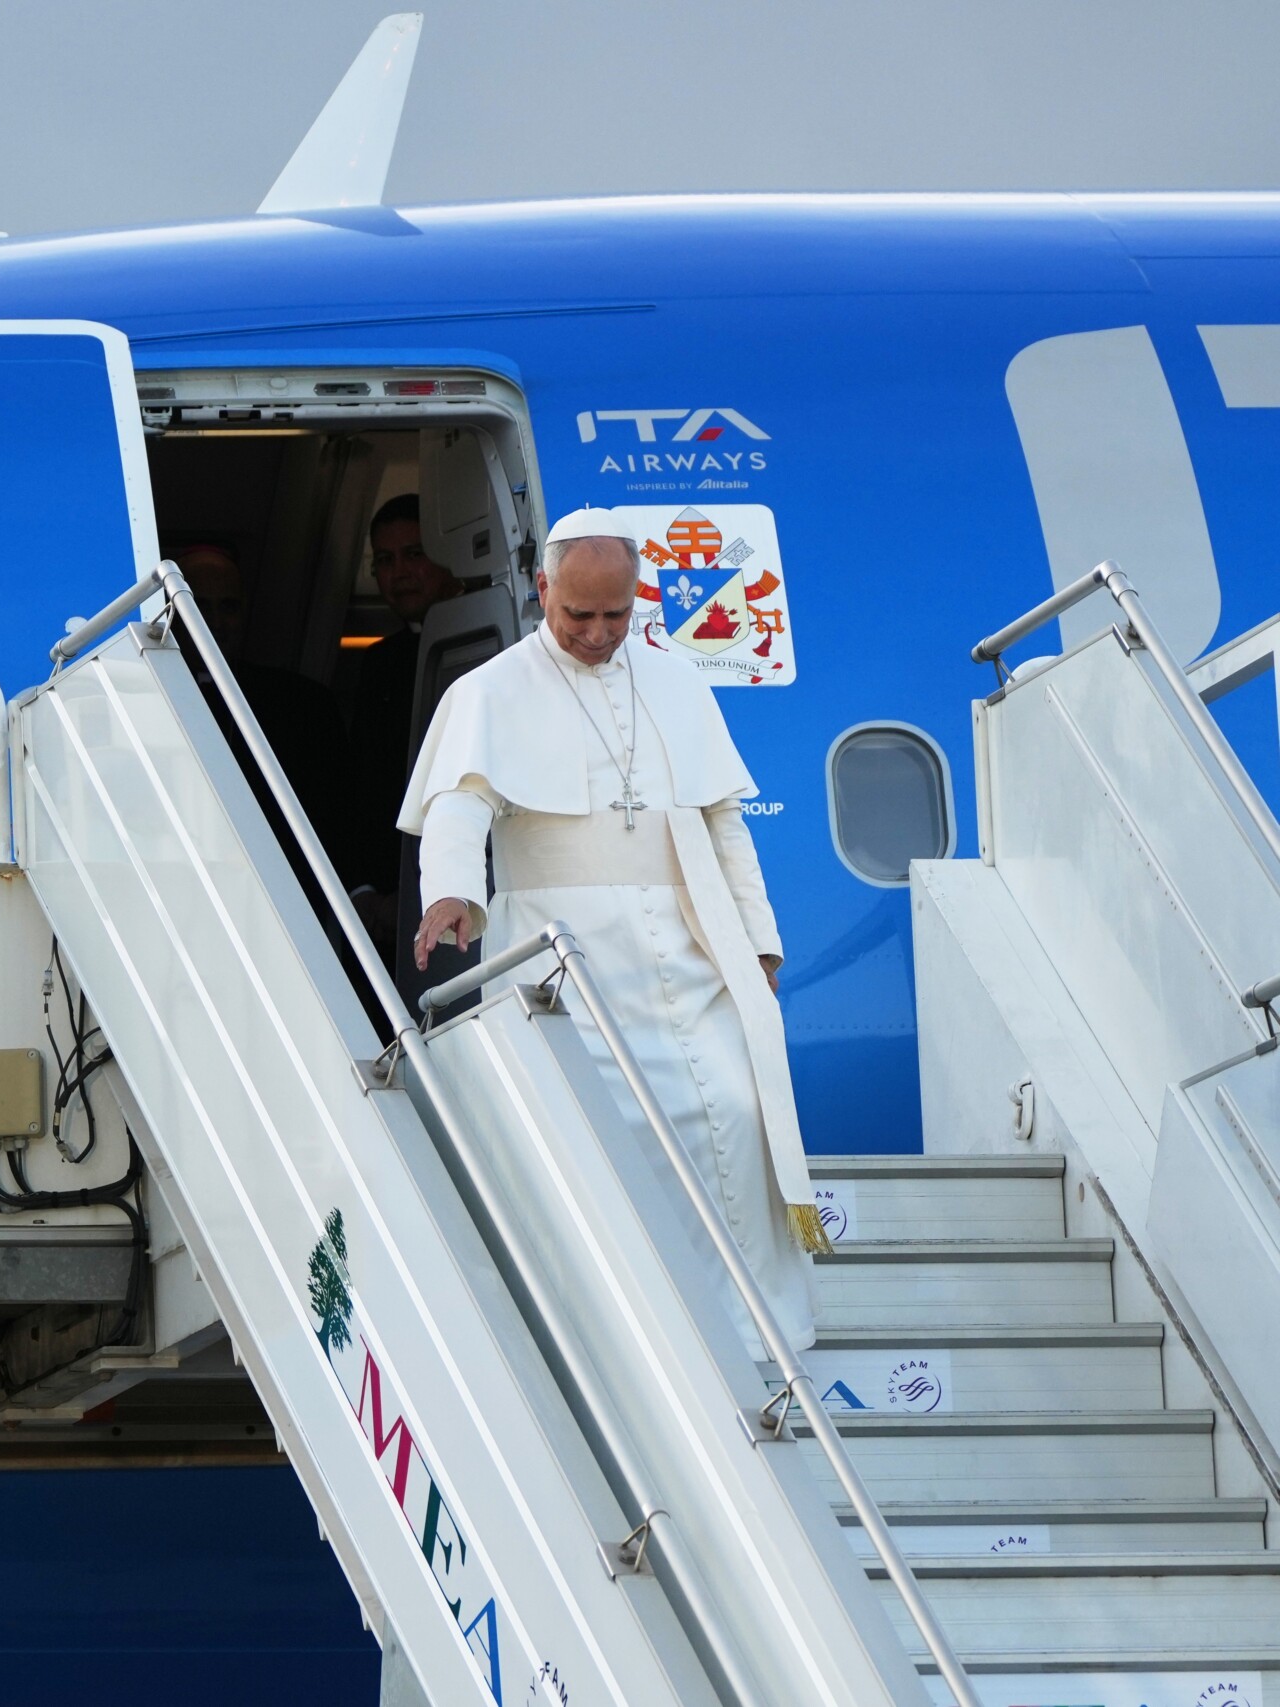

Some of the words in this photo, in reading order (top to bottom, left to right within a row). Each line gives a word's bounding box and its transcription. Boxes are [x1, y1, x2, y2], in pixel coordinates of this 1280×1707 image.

[576, 408, 772, 443] ITA
[599, 452, 767, 473] AIRWAYS
[626, 482, 676, 491] INSPIRED
[679, 482, 692, 490] BY
[696, 478, 749, 490] Alitalia
[702, 660, 726, 668] UNO
[728, 661, 760, 674] UNUM
[741, 802, 784, 815] ROUP
[888, 1360, 928, 1404] SKYTEAM
[352, 1334, 503, 1707] MEA
[990, 1536, 1027, 1552] TEAM
